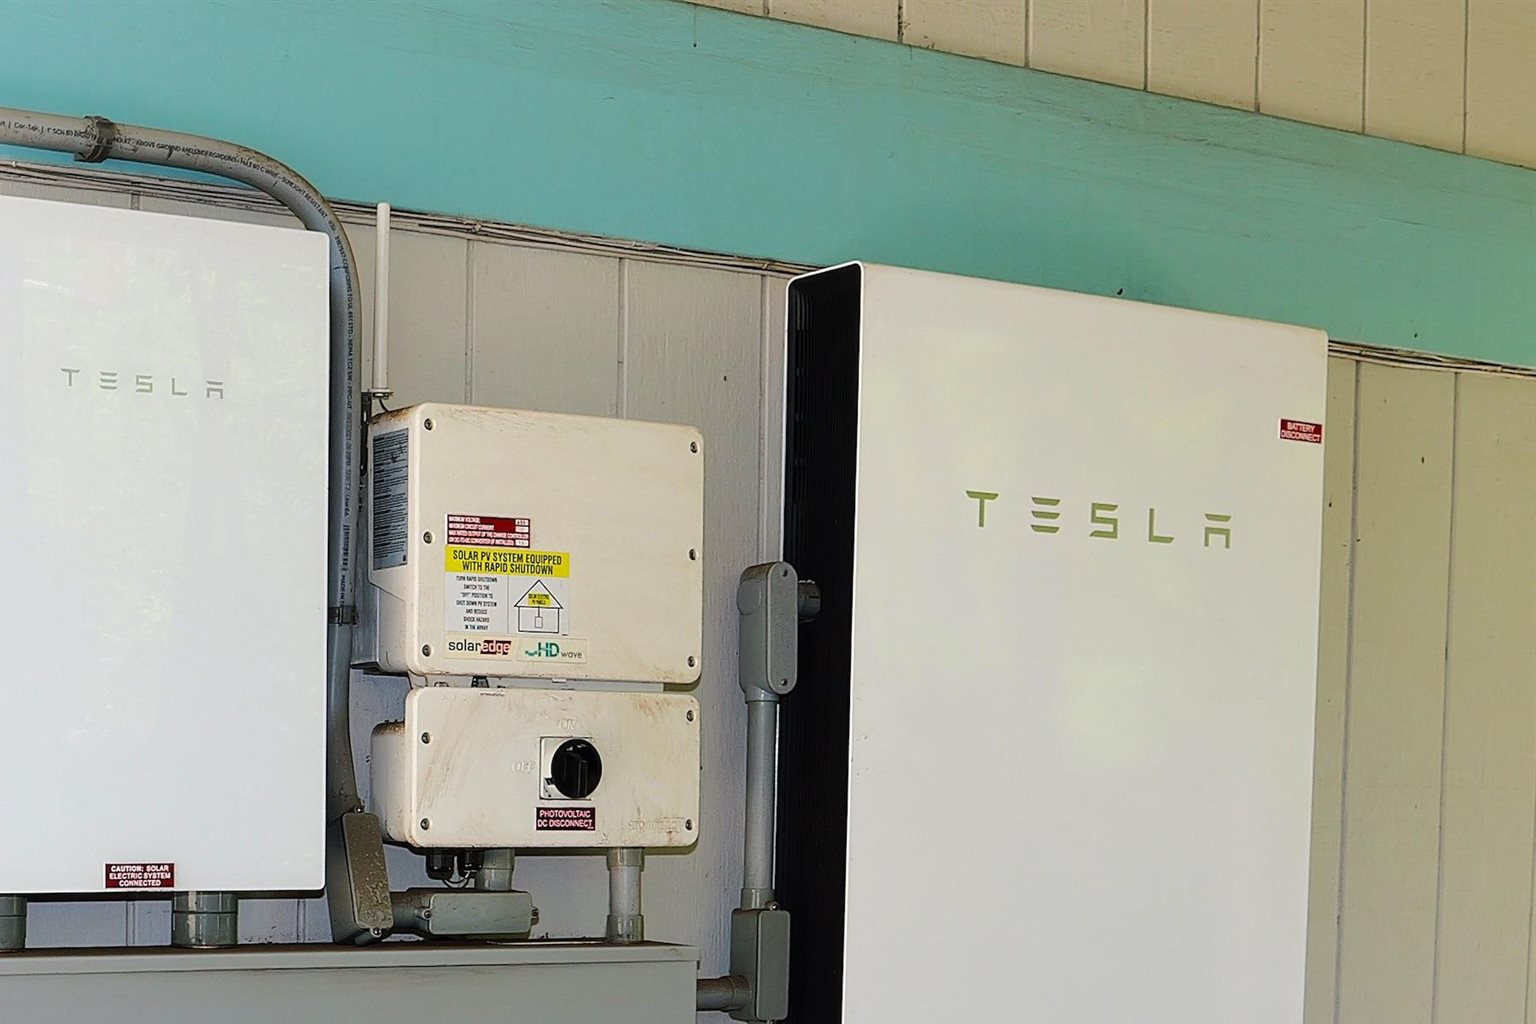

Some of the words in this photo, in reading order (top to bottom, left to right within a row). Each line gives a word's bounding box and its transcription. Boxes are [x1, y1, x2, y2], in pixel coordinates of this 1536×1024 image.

[60, 368, 223, 399] TESLA
[966, 490, 1232, 549] TESLA
[453, 550, 478, 560] SOLAR
[481, 552, 491, 561] PV
[493, 552, 523, 563] SYSTEM
[526, 554, 562, 565] EQUIPPED
[462, 561, 482, 571] WITH
[484, 562, 508, 572] RAPID
[510, 564, 553, 575] SHUTDOWN
[449, 639, 510, 655] solaredge
[538, 642, 559, 657] HD
[539, 810, 590, 818] PHOTOVOLTAIC
[549, 820, 592, 828] DISCONNECT
